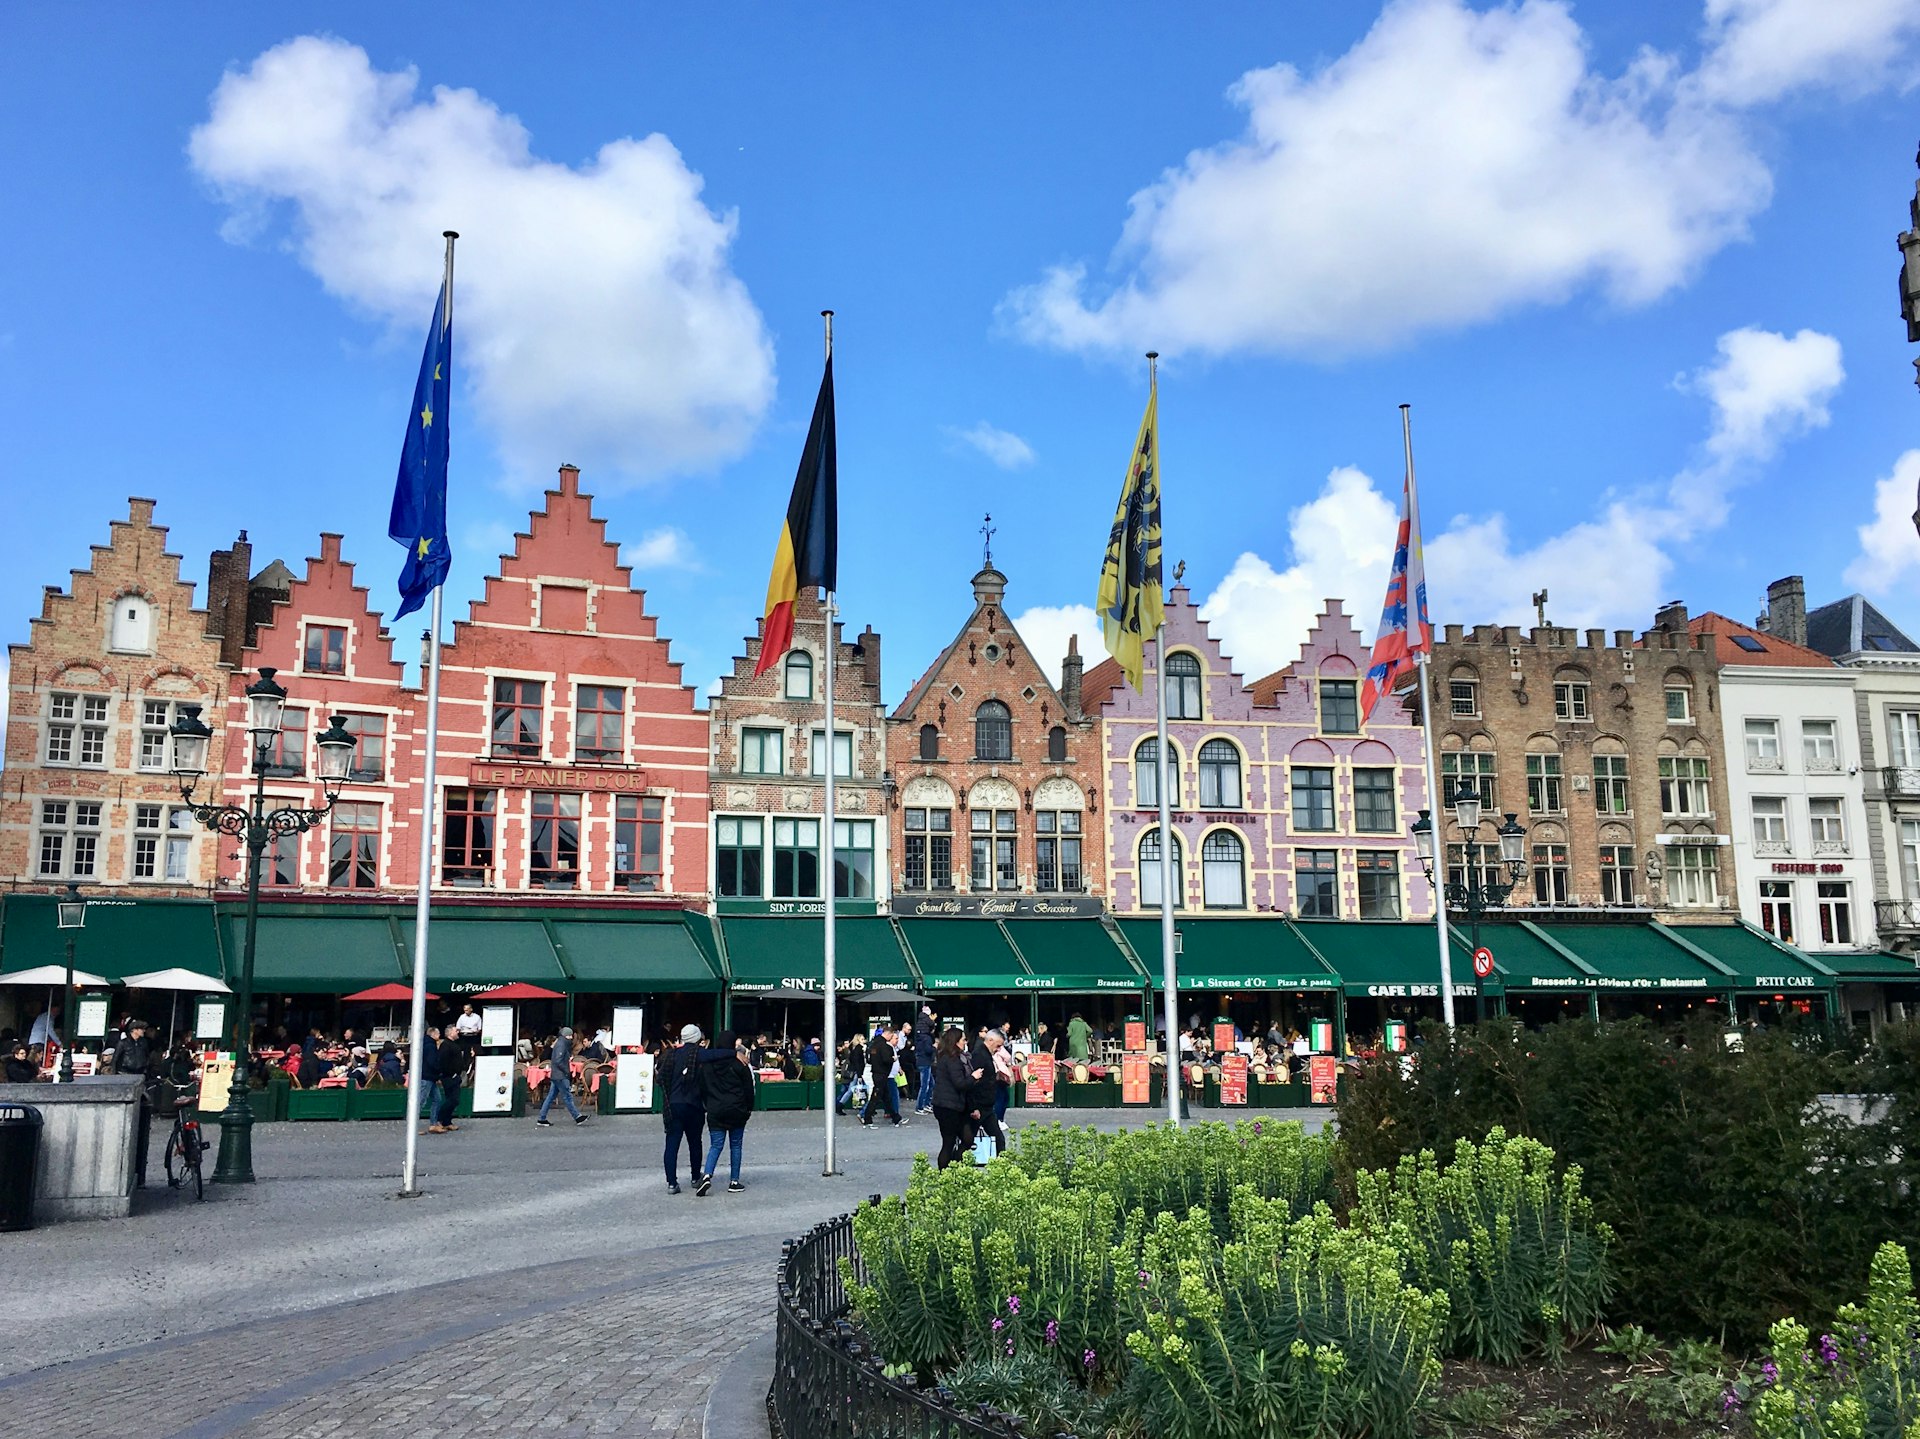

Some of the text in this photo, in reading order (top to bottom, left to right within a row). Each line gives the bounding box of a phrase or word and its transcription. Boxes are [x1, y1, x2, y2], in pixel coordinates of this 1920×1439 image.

[476, 768, 642, 790] LE PANIER D'OR
[770, 903, 826, 913] SINT JORIS
[916, 902, 943, 915] Grand
[979, 899, 1016, 915] Central
[1033, 903, 1077, 913] Brasserie
[872, 982, 908, 990] Brasserie
[935, 977, 1135, 987] Hotel Central Brasserie
[1191, 978, 1204, 987] La
[1207, 978, 1241, 987] Sirene
[1244, 978, 1267, 987] d'Or
[1310, 979, 1332, 987] pasta
[1532, 977, 1577, 986] Brasserie
[1585, 978, 1597, 986] La
[1632, 978, 1652, 987] d'Or
[1660, 978, 1707, 987] Restaurant
[1756, 976, 1815, 986] PETIT CAFE
[1367, 985, 1478, 997] CAFE DES ART
